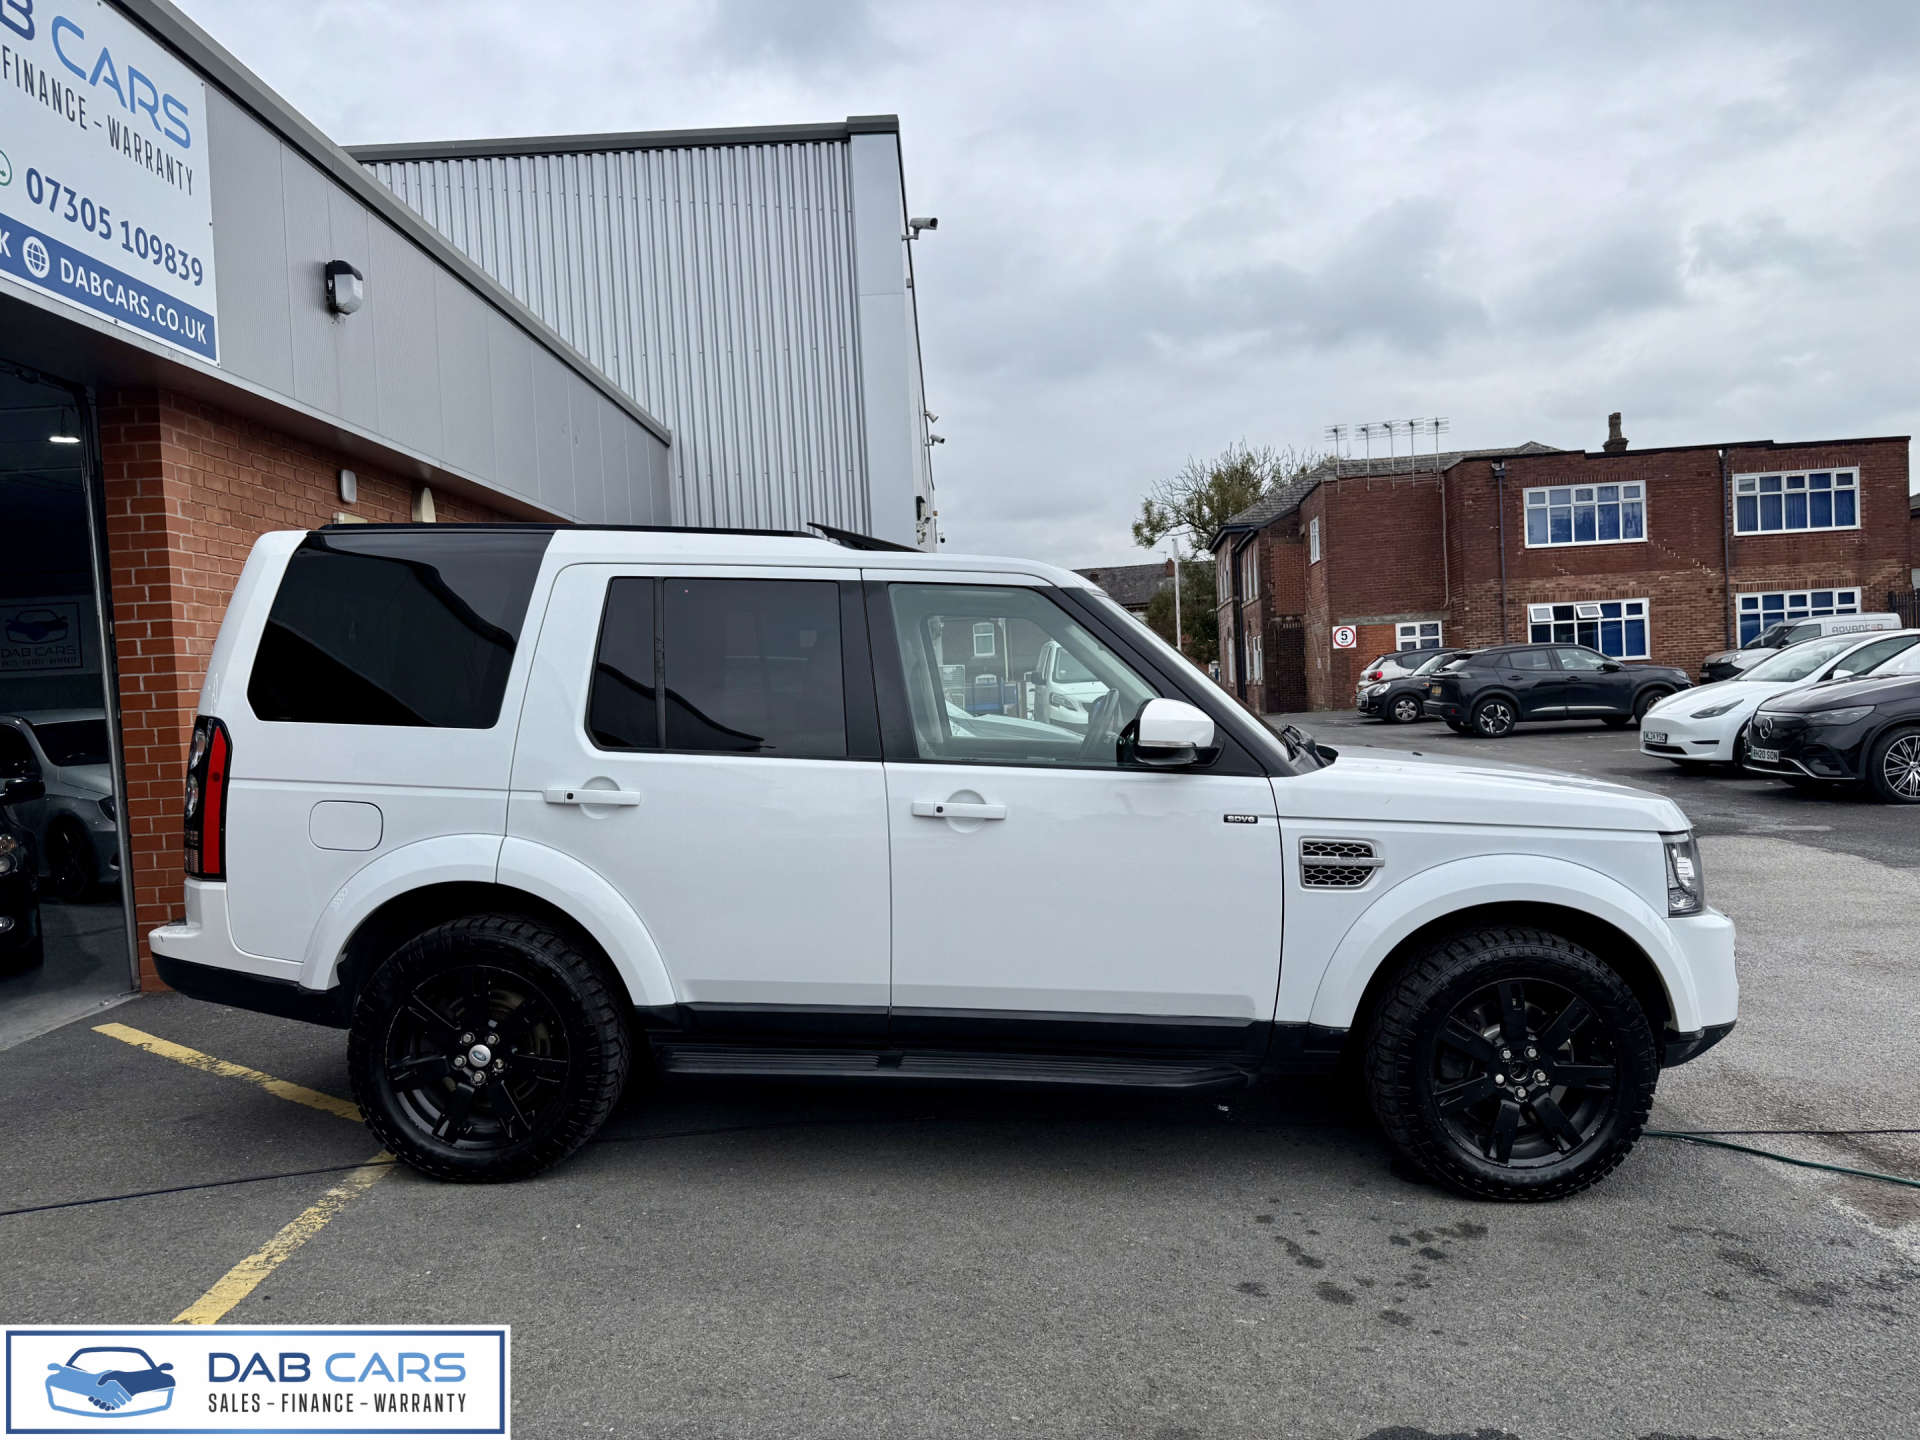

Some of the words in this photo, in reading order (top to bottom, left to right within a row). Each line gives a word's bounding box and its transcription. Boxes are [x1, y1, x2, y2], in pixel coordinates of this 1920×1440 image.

[2, 44, 87, 130] FINANCE
[107, 115, 193, 196] WARRANTY
[51, 15, 191, 149] CARS
[26, 167, 112, 240] 07305
[120, 220, 203, 286] 109839
[60, 257, 207, 345] DABCARS.CO.UK
[1341, 630, 1348, 641] 5
